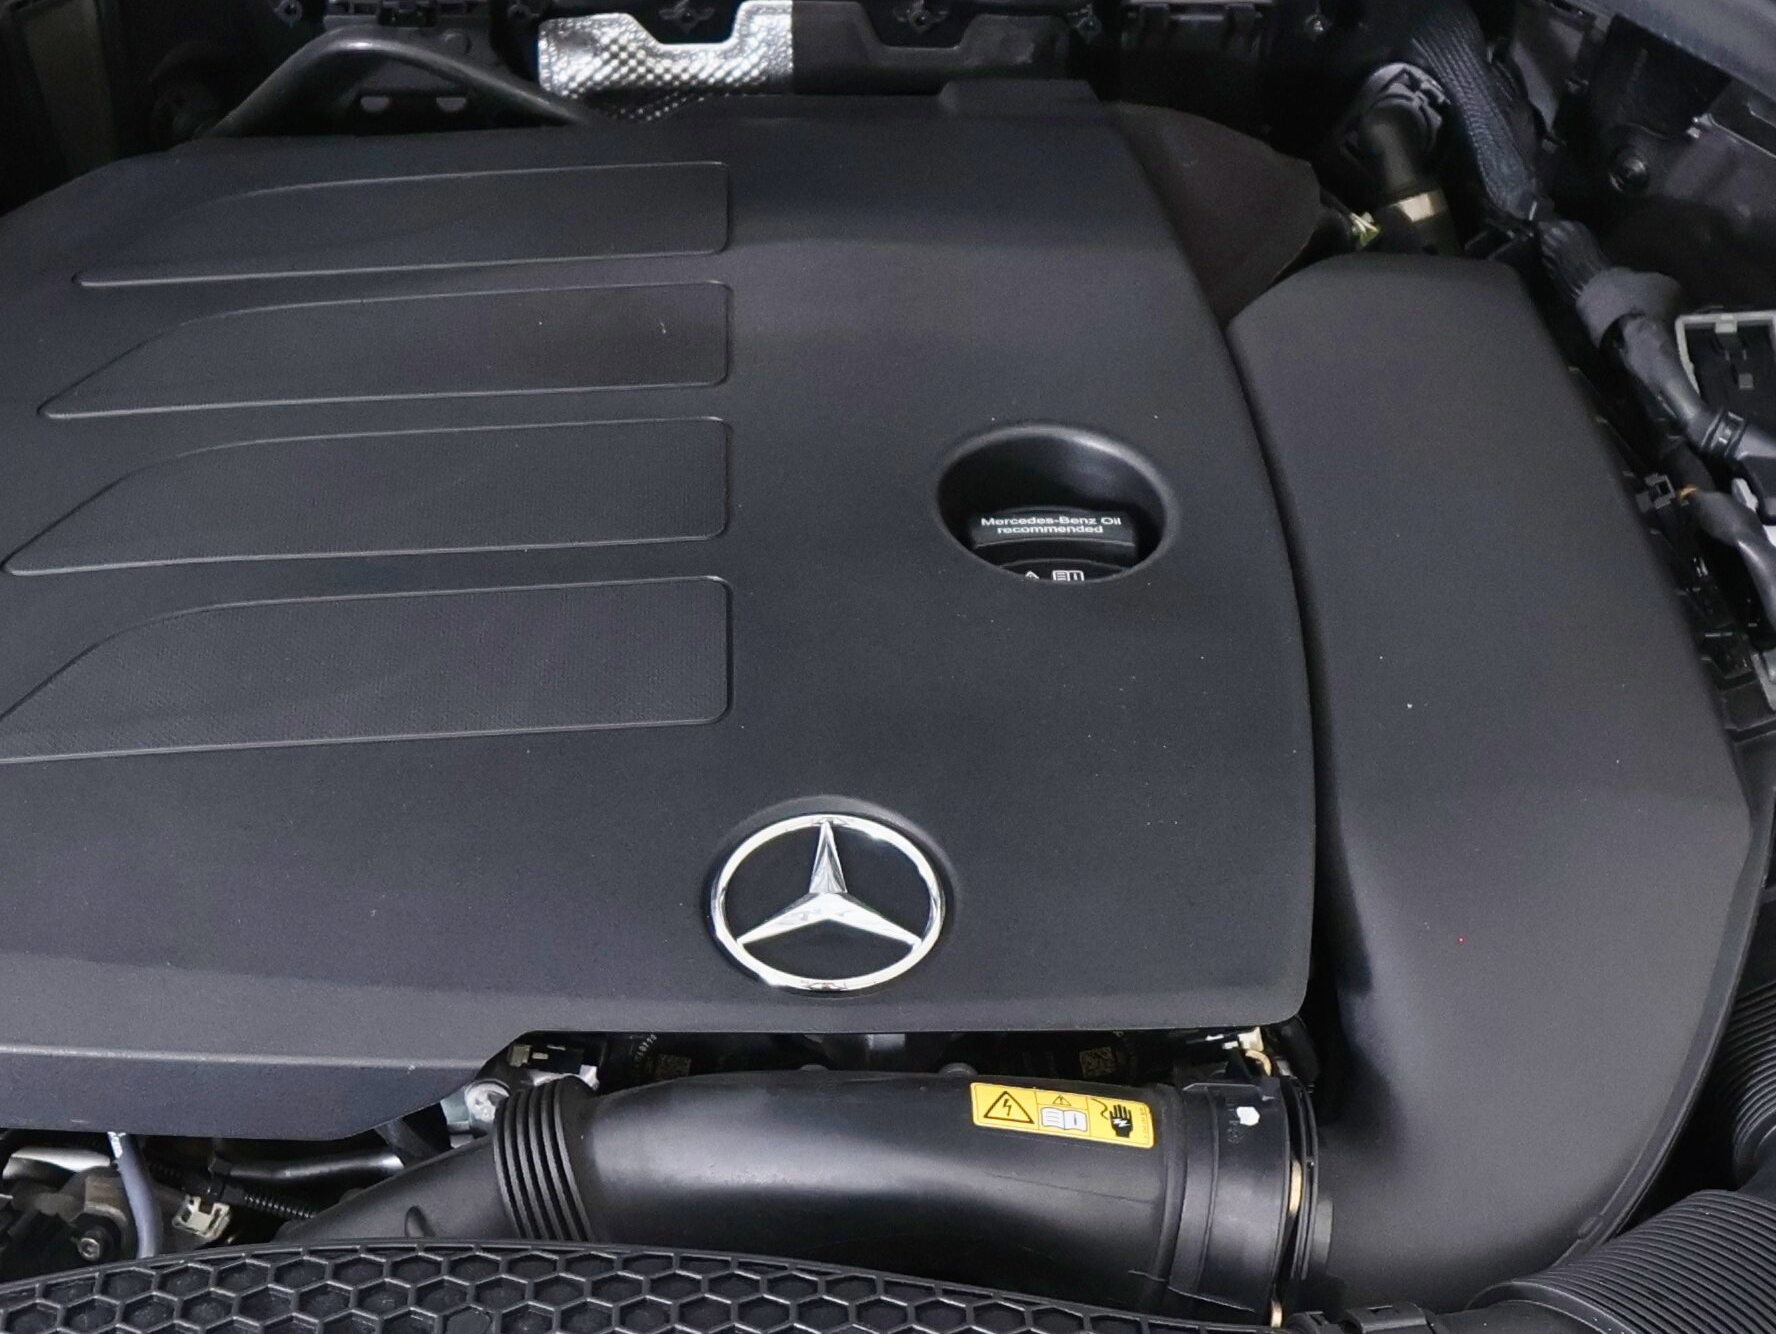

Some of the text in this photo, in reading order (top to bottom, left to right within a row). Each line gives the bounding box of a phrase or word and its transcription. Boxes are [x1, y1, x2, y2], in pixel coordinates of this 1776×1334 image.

[981, 515, 1122, 525] Mercedes-Benz Oil
[998, 525, 1103, 534] recommended
